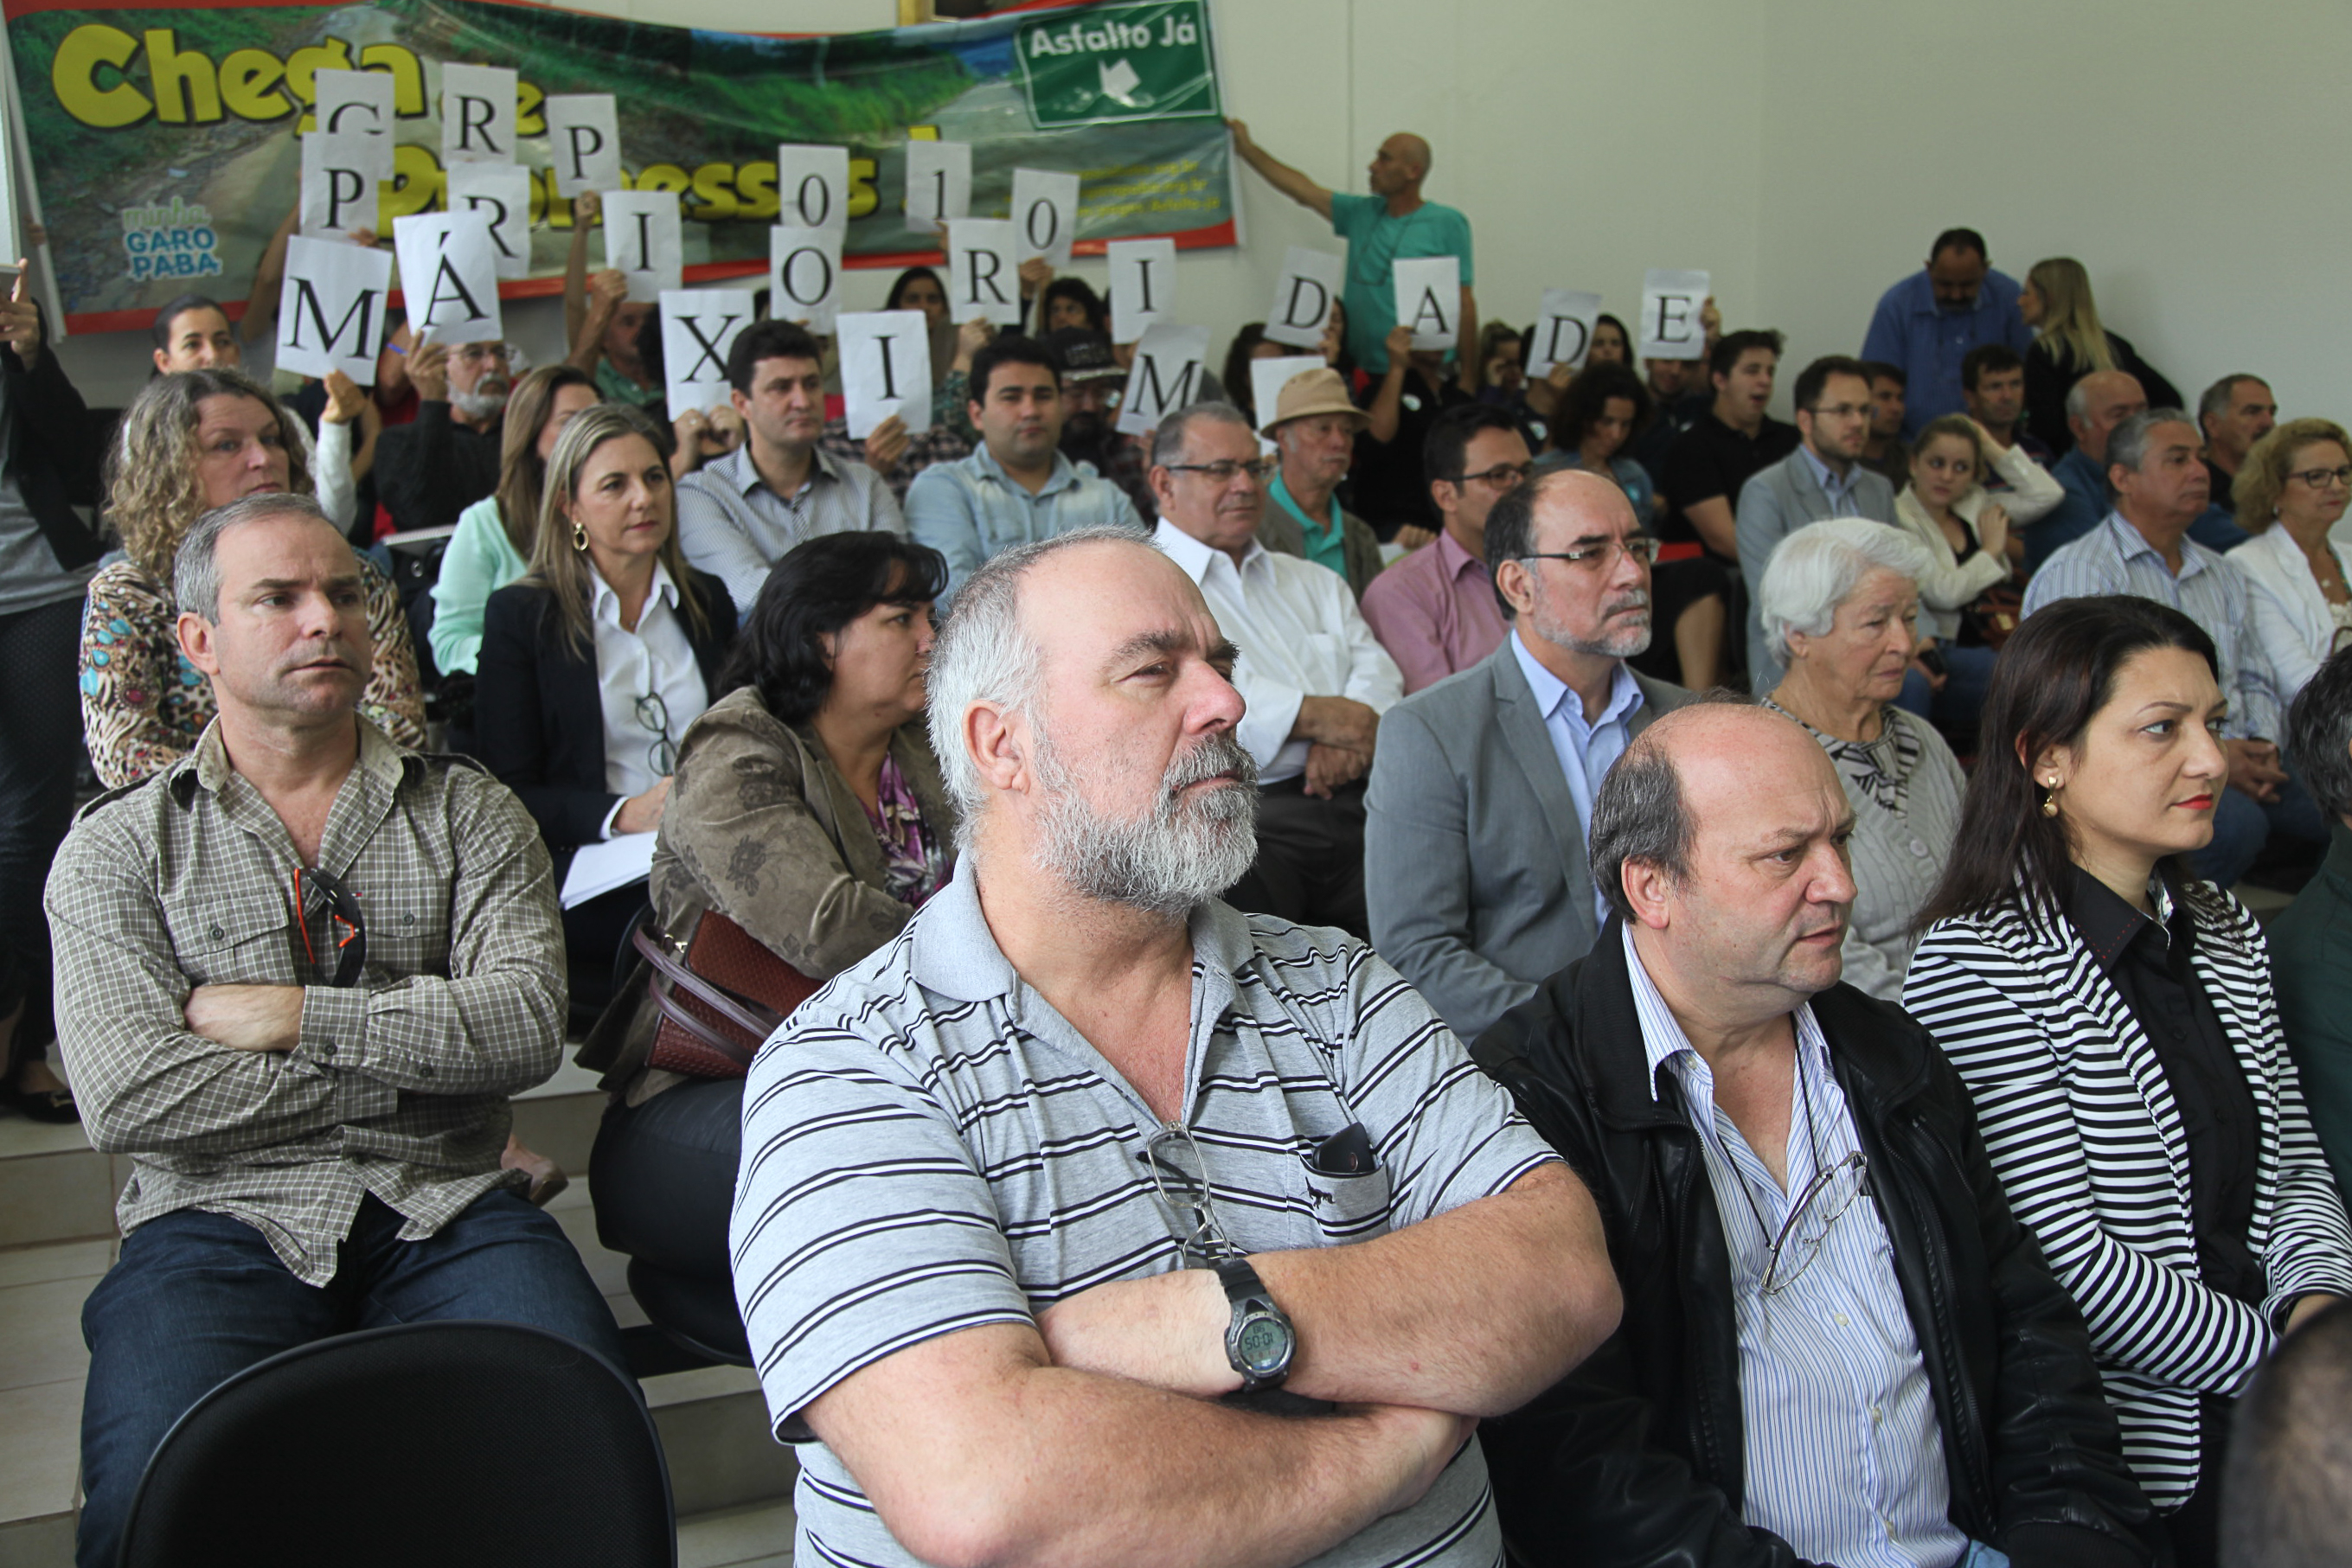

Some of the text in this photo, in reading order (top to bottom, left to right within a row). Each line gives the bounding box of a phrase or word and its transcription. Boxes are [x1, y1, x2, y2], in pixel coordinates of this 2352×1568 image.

[1030, 13, 1196, 58] Asfalto Já
[455, 95, 505, 154] R
[565, 125, 604, 180] P
[123, 198, 211, 227] minha
[321, 168, 364, 228] P
[126, 227, 214, 253] GARO
[461, 195, 519, 258] R
[632, 213, 652, 272] I
[133, 253, 218, 277] PABA
[963, 249, 1010, 304] R
[1137, 259, 1156, 313] I
[284, 277, 383, 360] M
[1280, 274, 1328, 329] D
[1411, 286, 1449, 334] A
[1654, 295, 1692, 342] E
[673, 314, 741, 384] X
[1544, 315, 1588, 365] D
[872, 336, 902, 400] I
[1128, 354, 1202, 415] M
